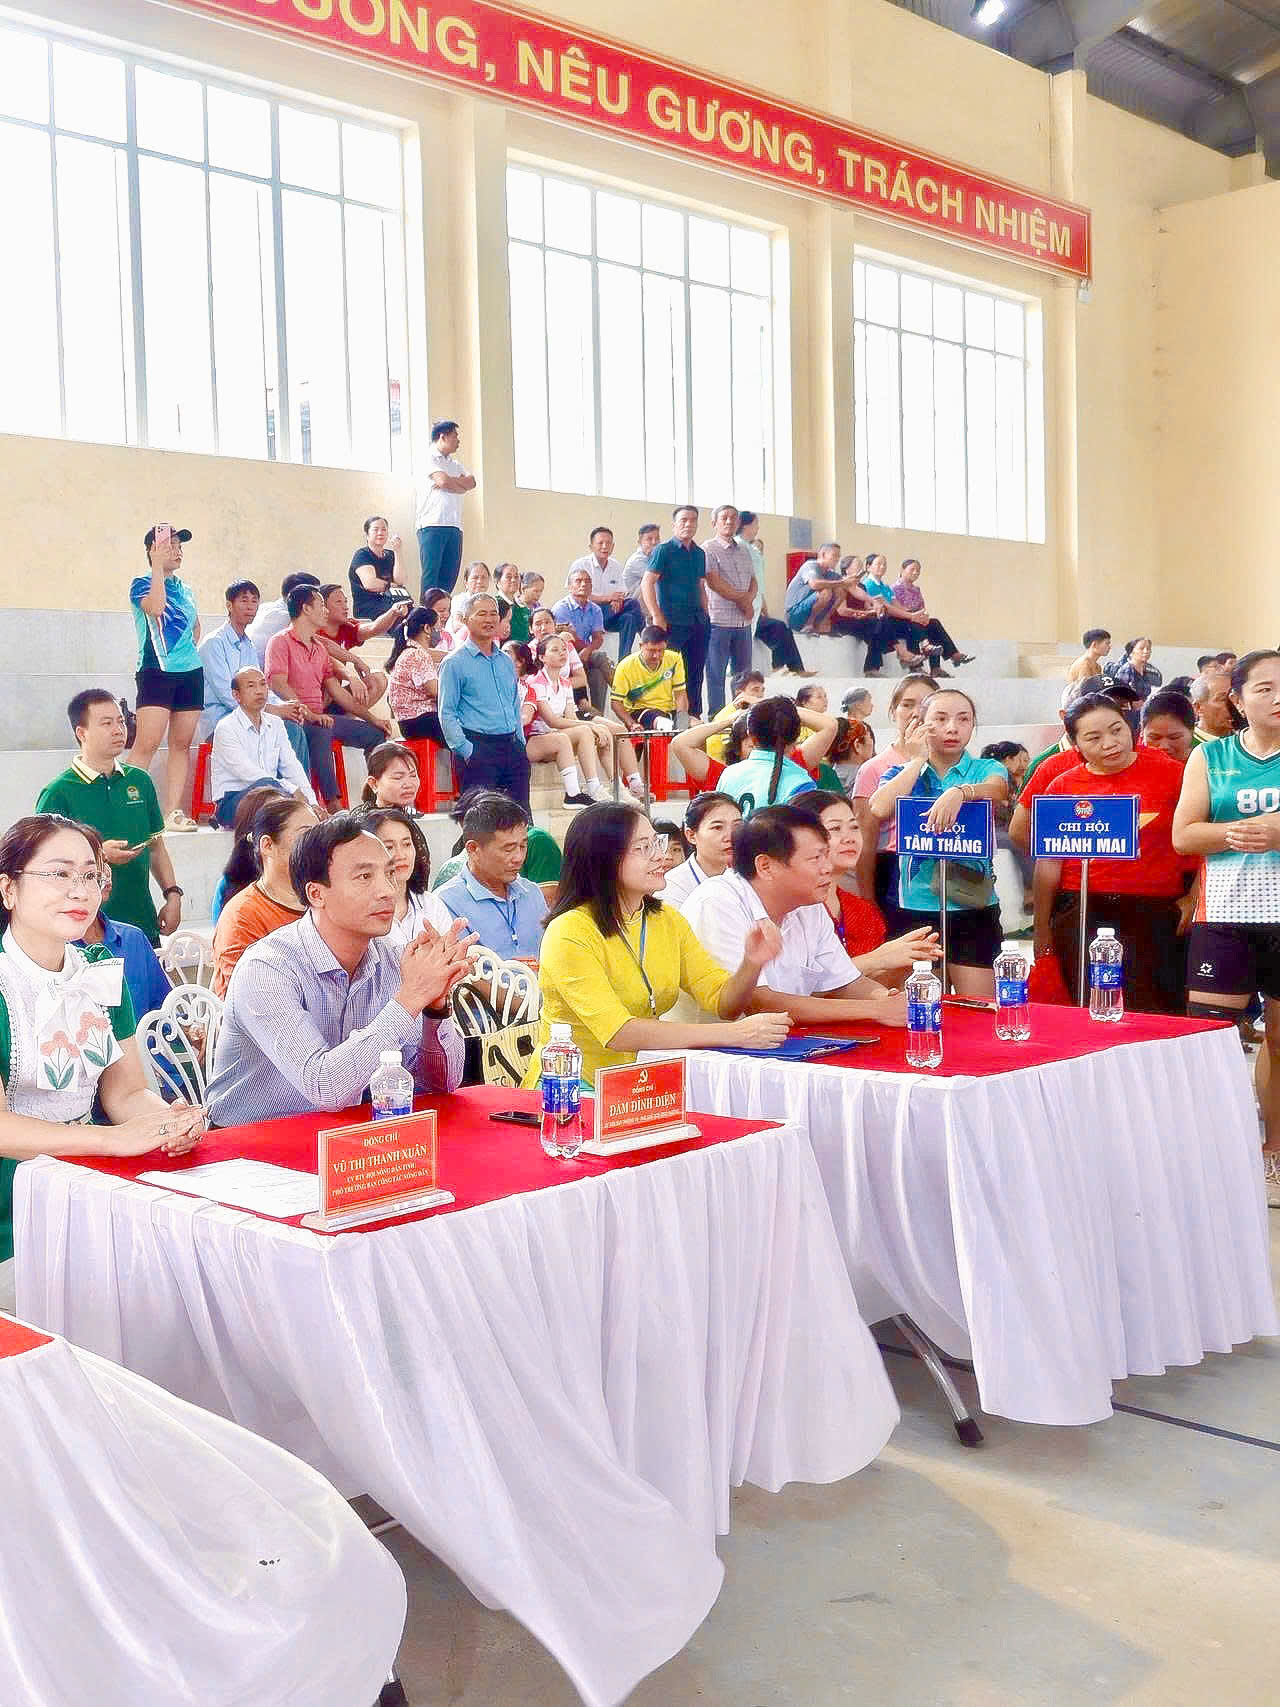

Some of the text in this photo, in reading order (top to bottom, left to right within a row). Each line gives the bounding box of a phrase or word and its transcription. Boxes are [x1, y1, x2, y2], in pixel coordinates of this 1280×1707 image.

[517, 40, 632, 115] NÊU
[647, 86, 825, 185] GƯƠNG,
[837, 148, 963, 223] TRÁCH
[975, 195, 1072, 257] NHIỆM
[1236, 787, 1280, 814] 80
[1058, 820, 1110, 834] CHI HỘI
[1043, 834, 1127, 853] THÀNH MAI
